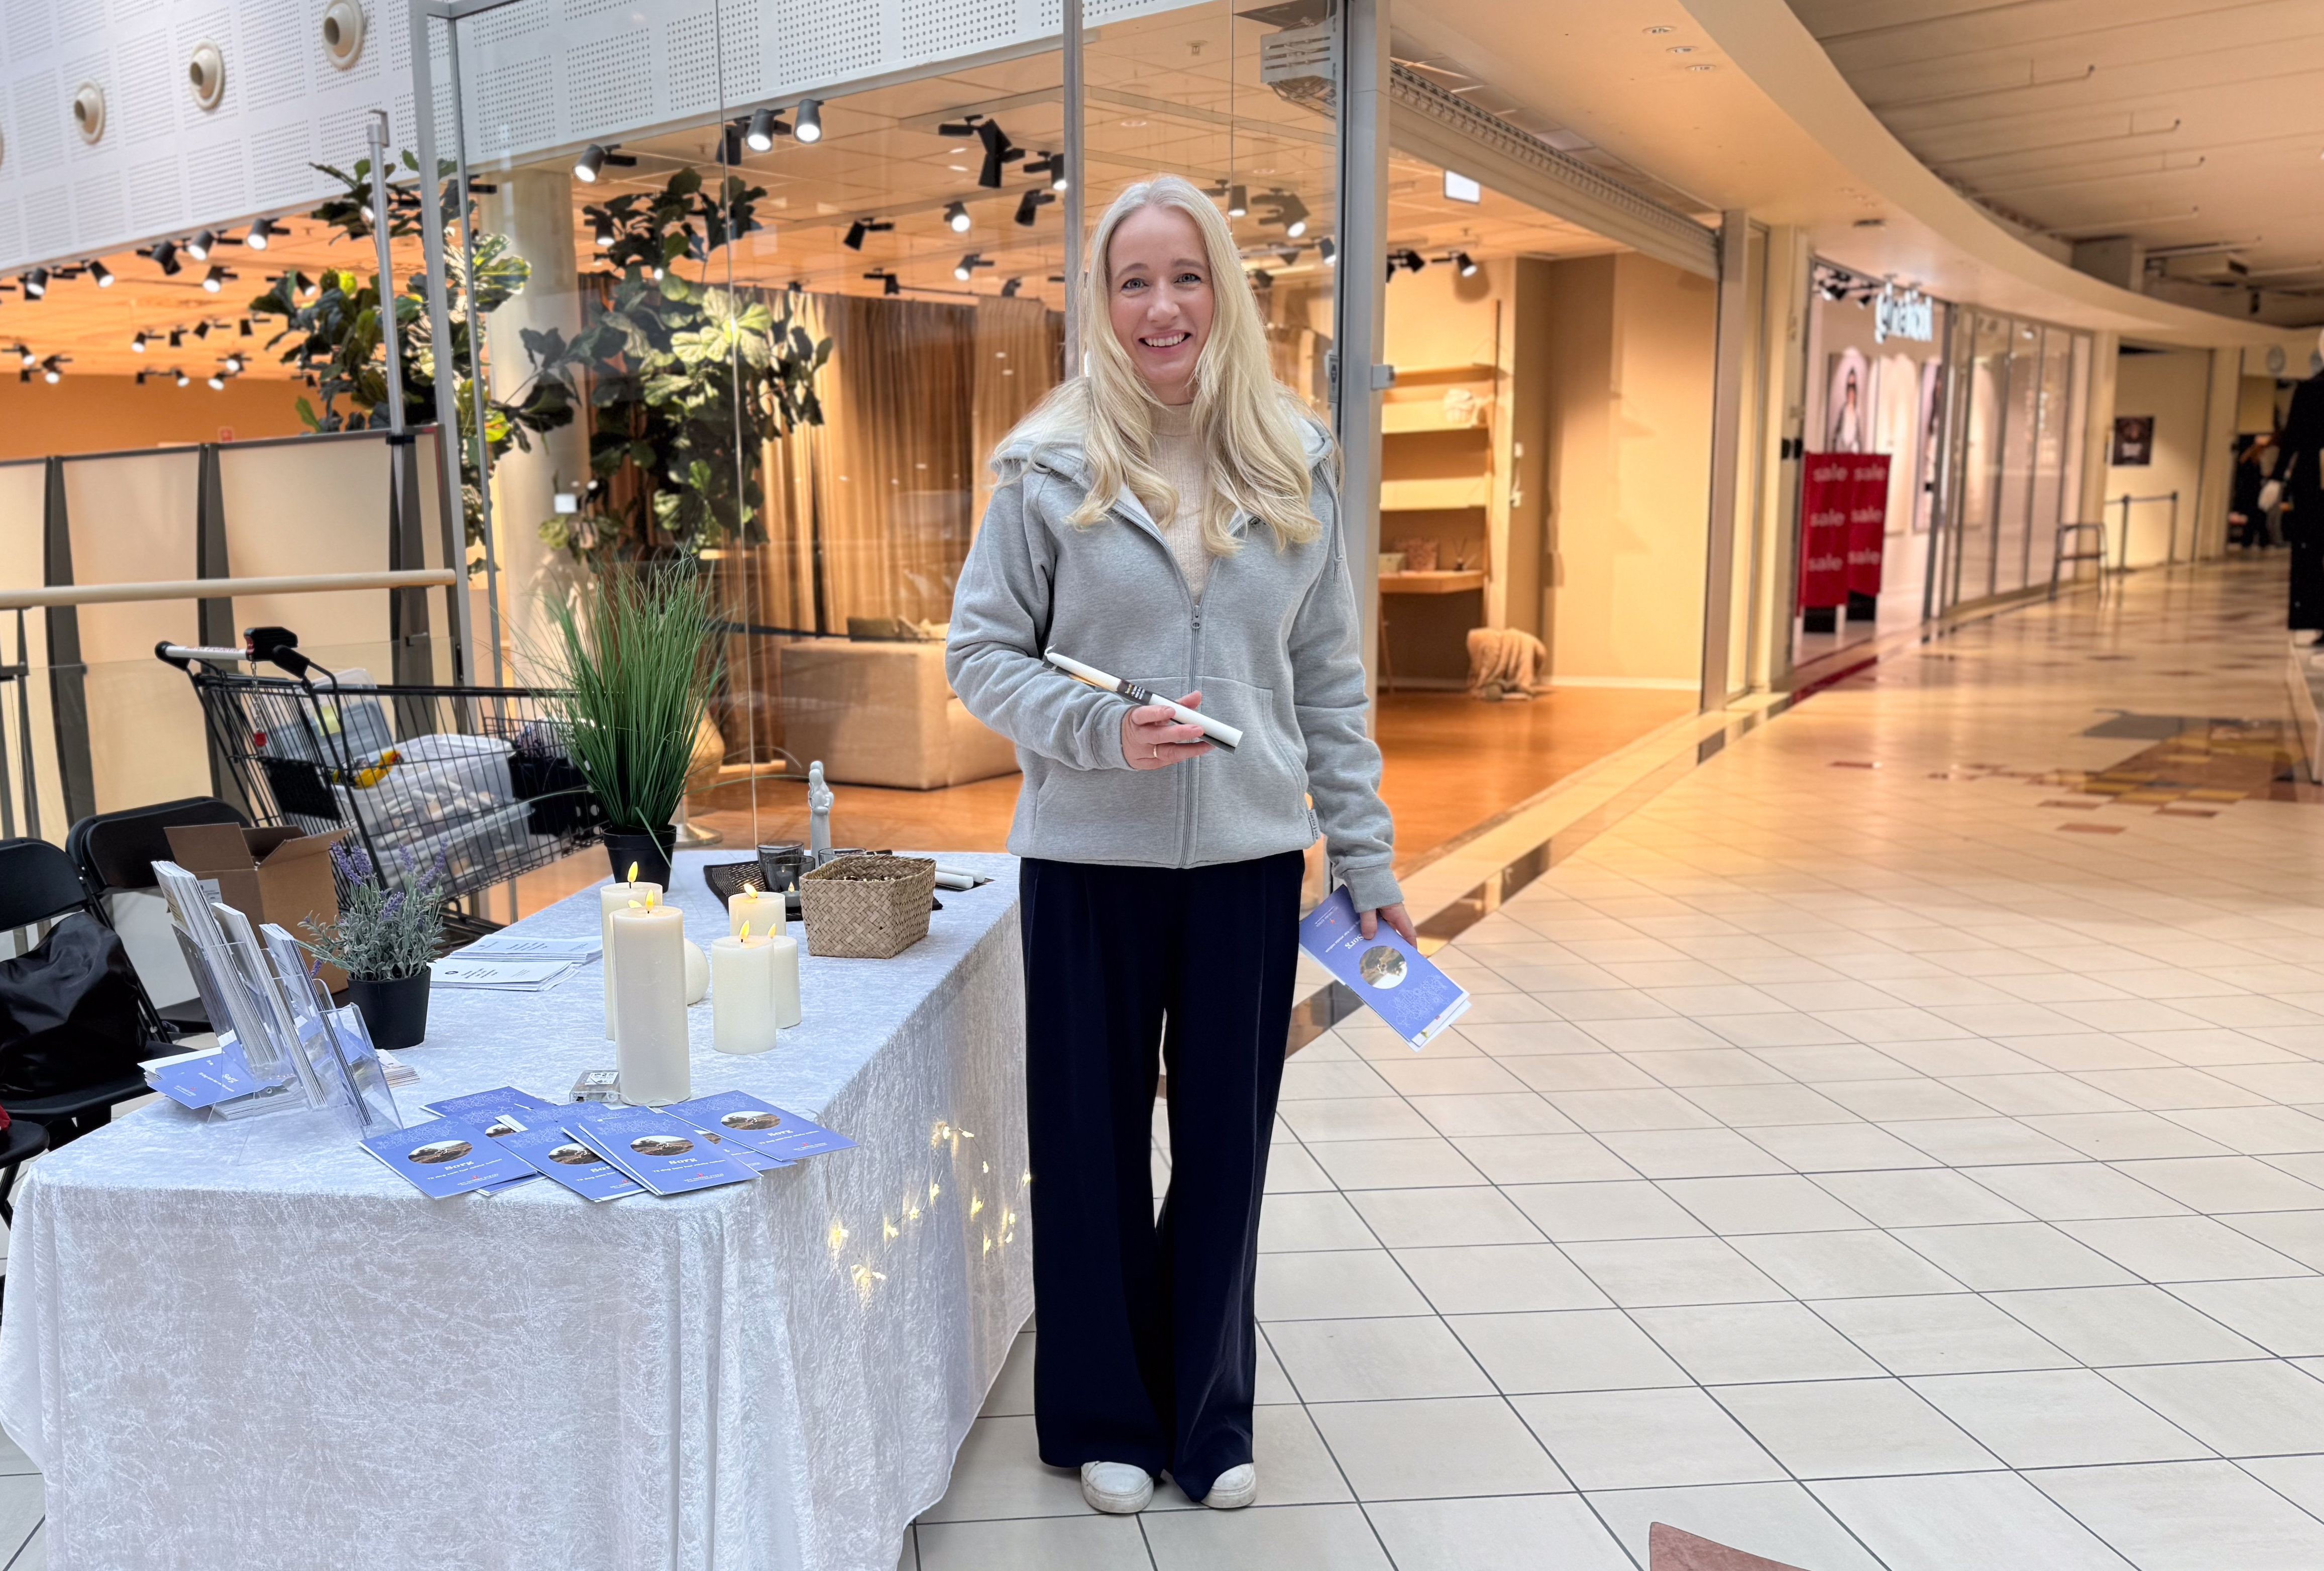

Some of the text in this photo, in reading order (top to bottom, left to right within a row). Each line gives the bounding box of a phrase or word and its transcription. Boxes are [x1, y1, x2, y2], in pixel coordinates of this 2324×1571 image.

[1813, 462, 1848, 482] sale
[1853, 463, 1887, 482] sale
[1810, 508, 1845, 527] sale
[1850, 505, 1883, 523] sale
[1808, 553, 1843, 572] sale
[1847, 547, 1881, 565] sale
